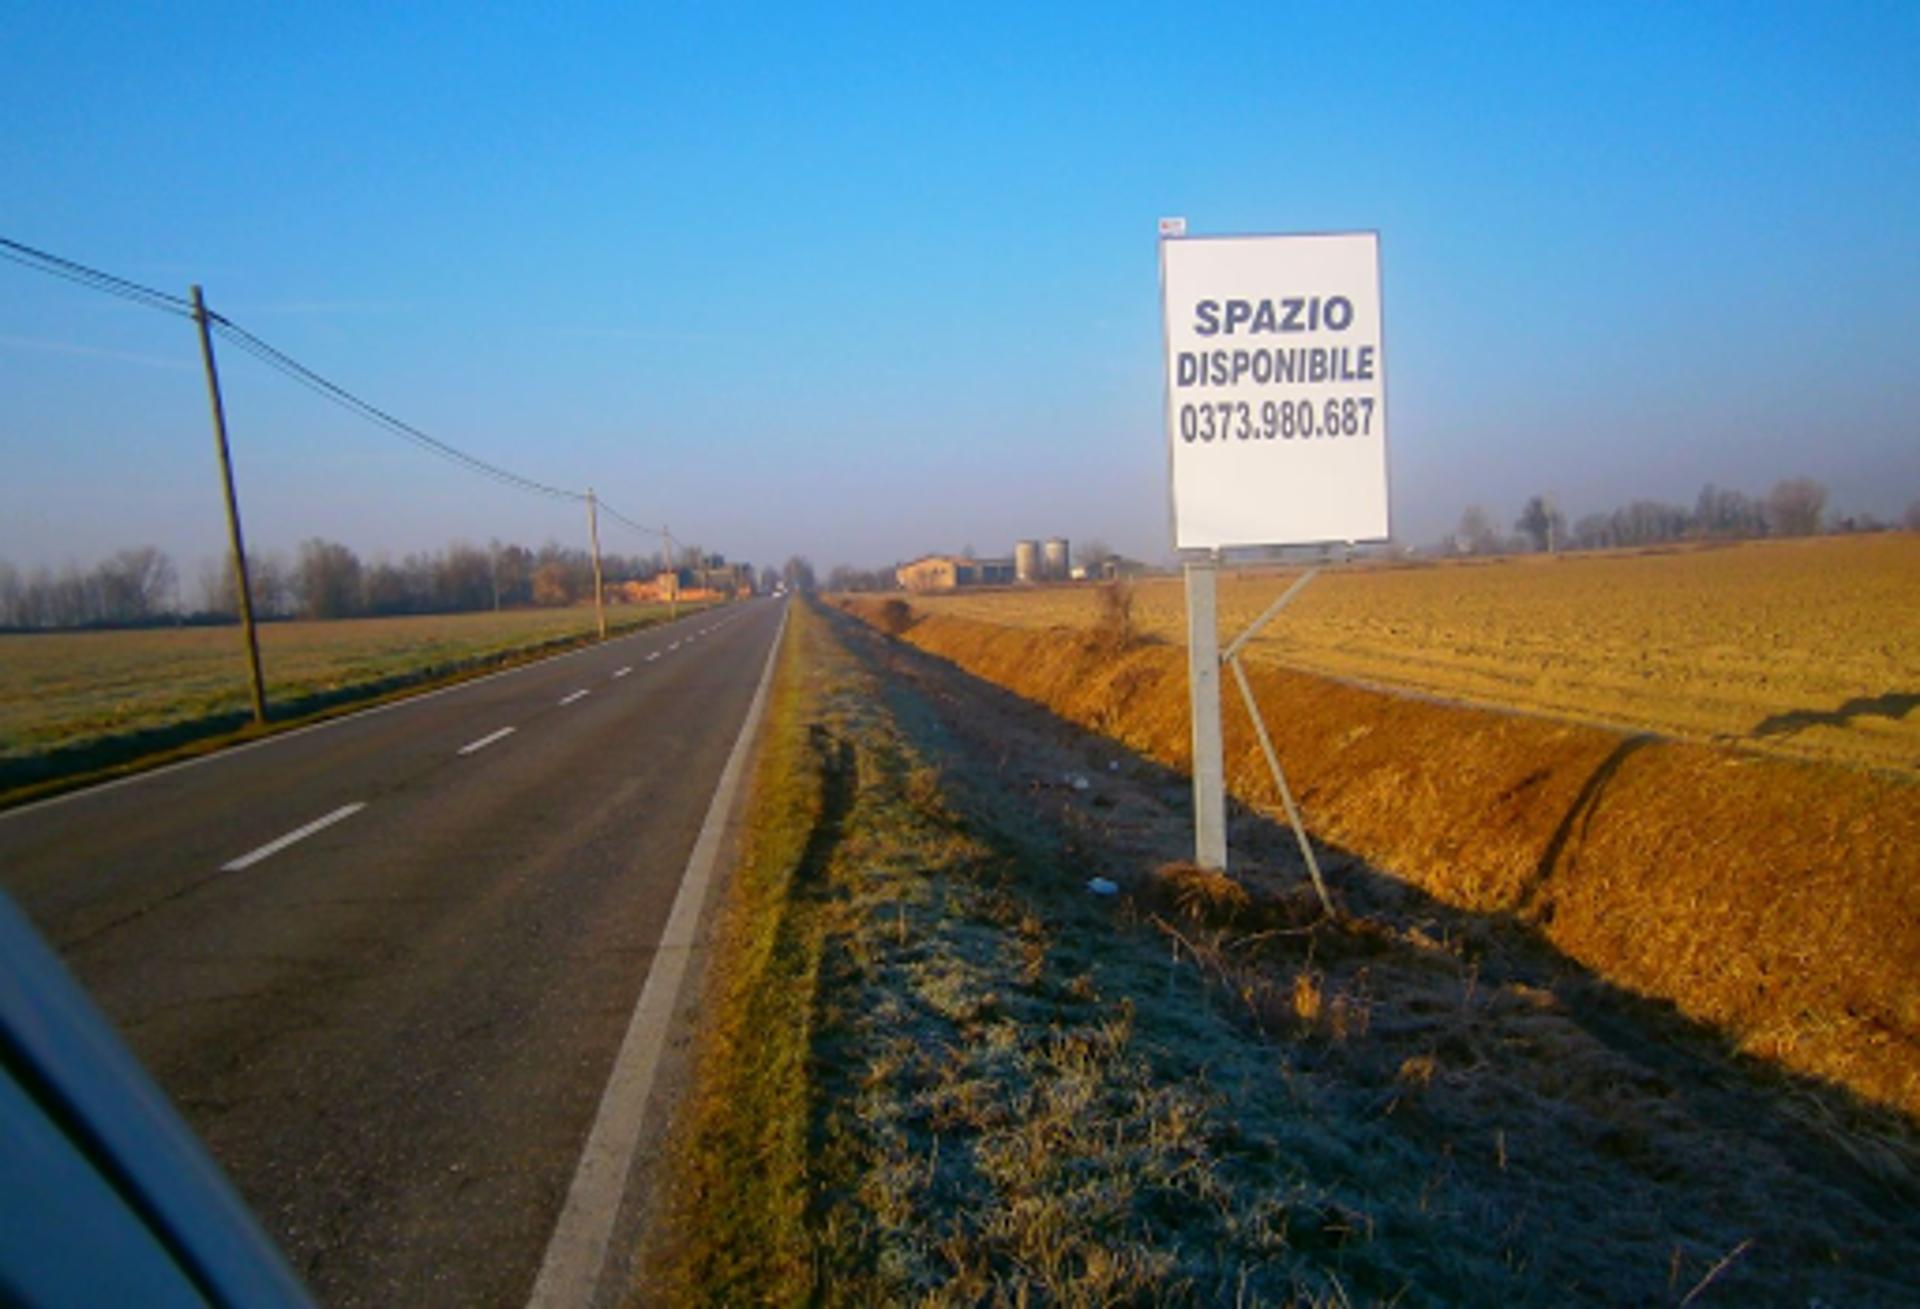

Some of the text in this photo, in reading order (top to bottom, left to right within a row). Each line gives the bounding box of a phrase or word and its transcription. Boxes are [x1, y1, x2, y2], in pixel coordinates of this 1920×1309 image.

[1195, 296, 1354, 335] SPAZIO
[1177, 346, 1374, 387] DISPONIBILE
[1180, 397, 1375, 442] 0373.980.687
